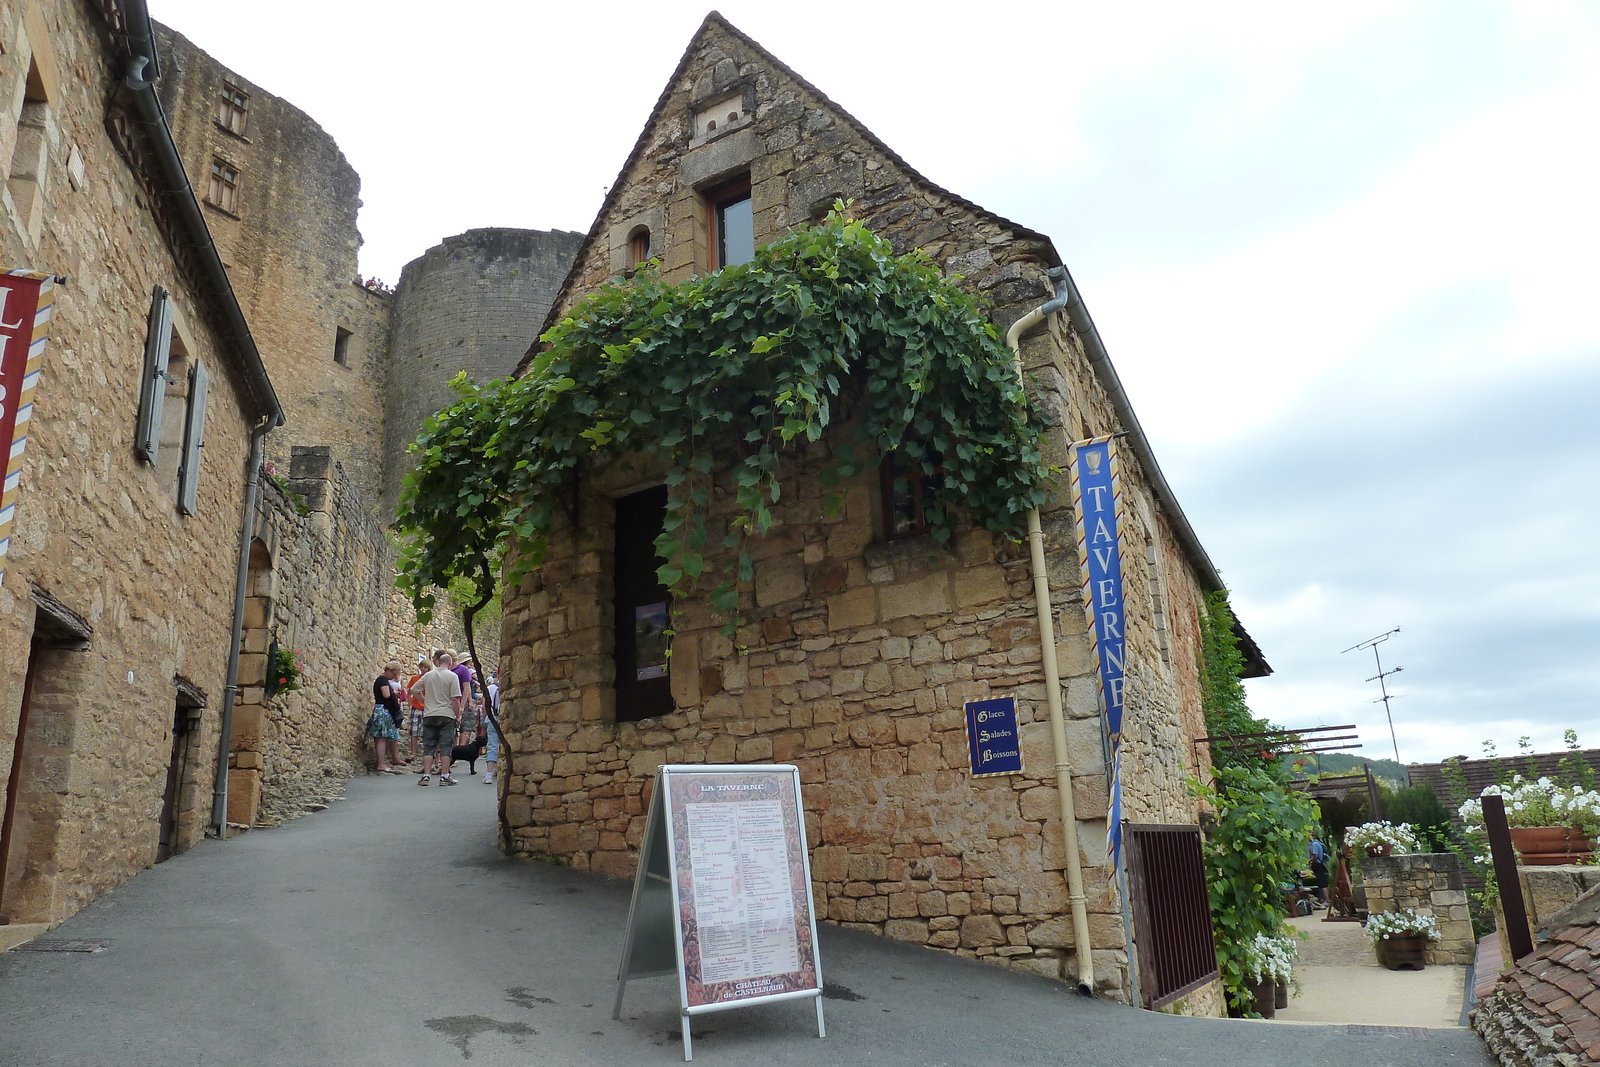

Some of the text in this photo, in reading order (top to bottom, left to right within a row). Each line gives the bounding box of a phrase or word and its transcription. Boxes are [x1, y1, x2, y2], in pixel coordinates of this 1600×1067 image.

[1087, 485, 1124, 708] TAVERNE
[977, 710, 1006, 723] Glaces
[979, 729, 1012, 743] Salades
[982, 749, 1018, 764] Boissons
[734, 984, 784, 997] CASTELNAUD
